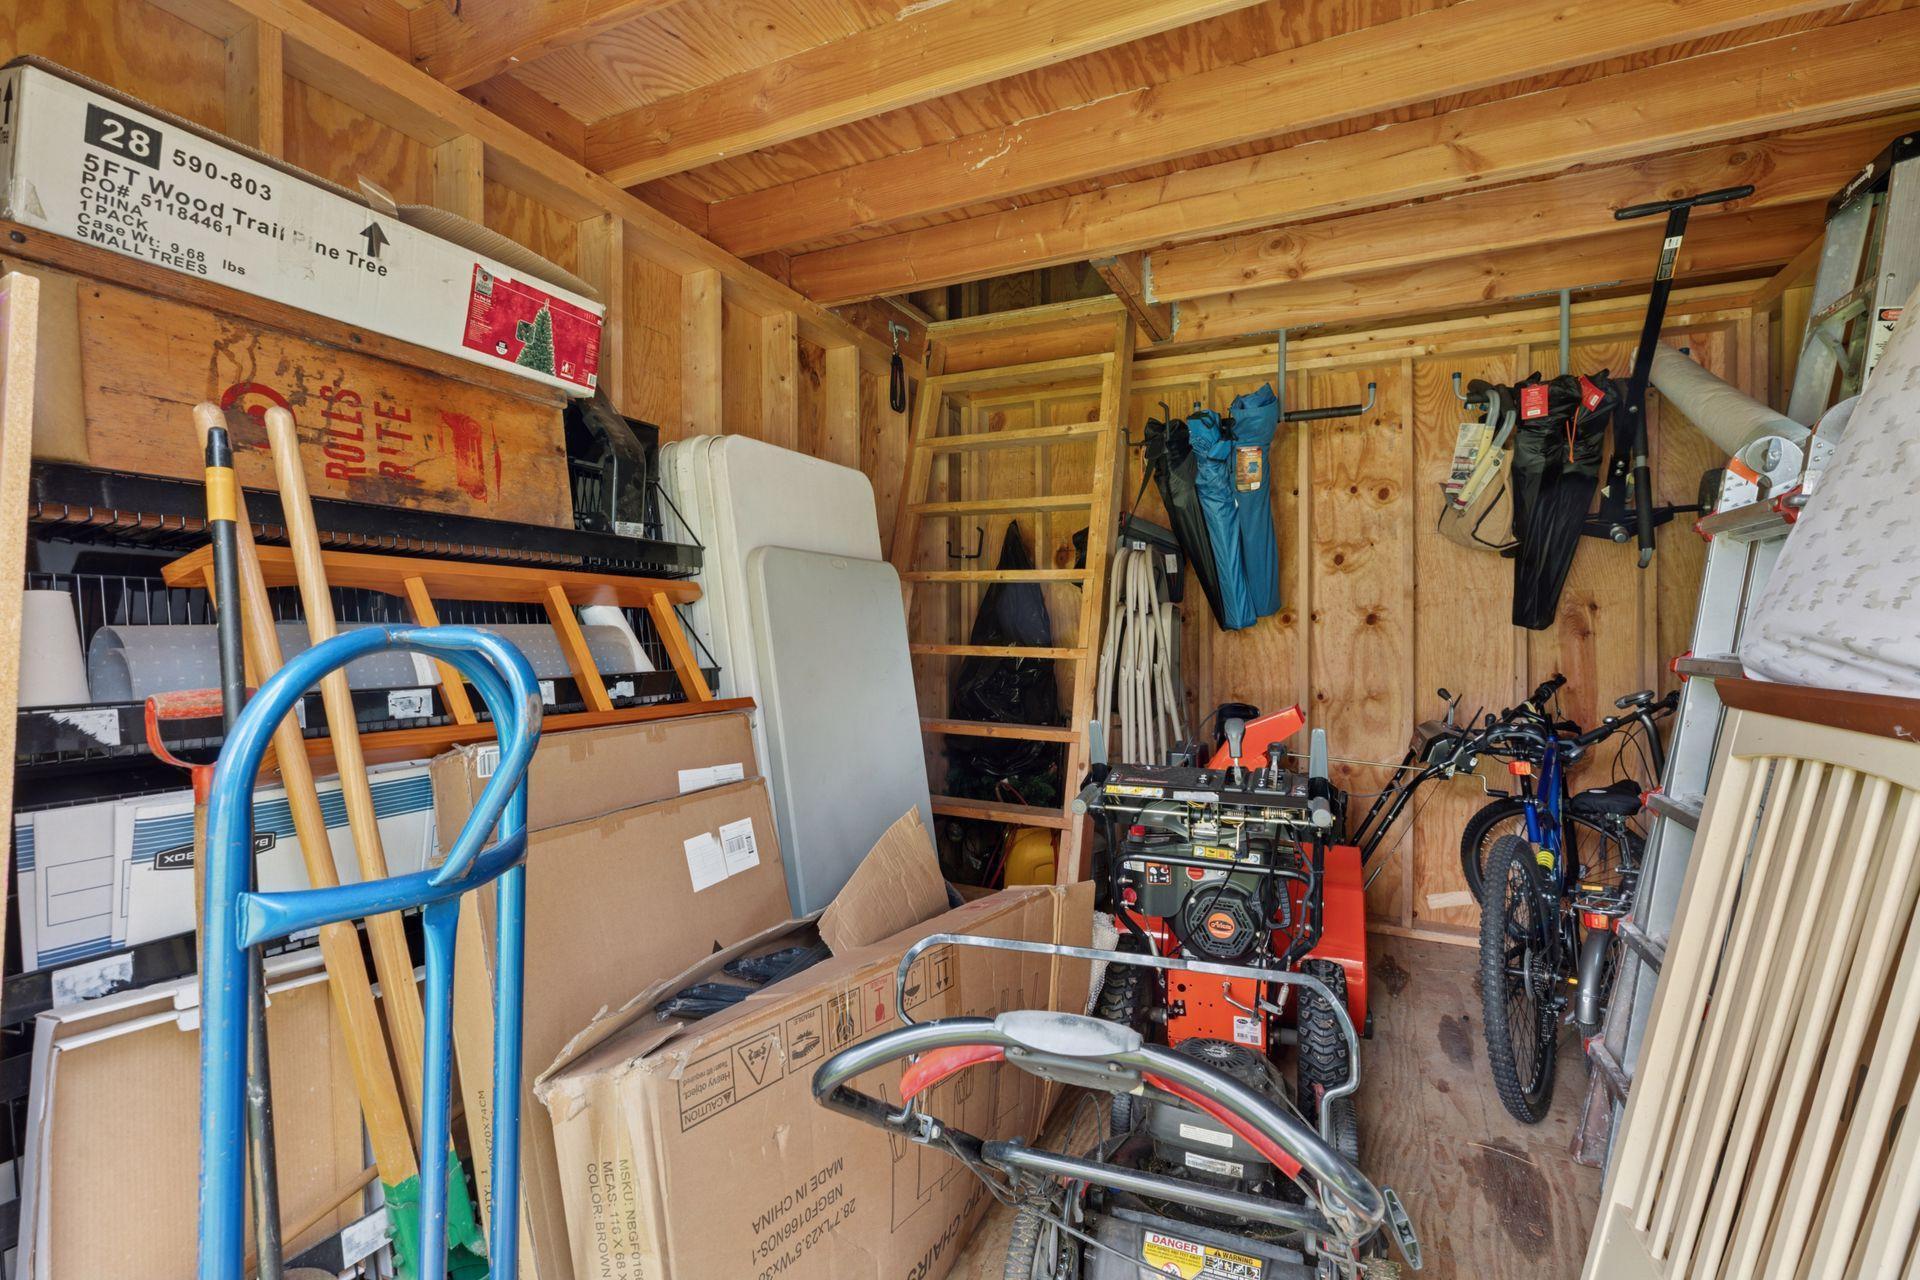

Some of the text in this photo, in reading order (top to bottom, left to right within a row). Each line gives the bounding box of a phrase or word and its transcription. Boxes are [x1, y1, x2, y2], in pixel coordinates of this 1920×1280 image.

[100, 118, 150, 158] 28
[172, 148, 271, 201] 590-803
[80, 186, 143, 217] CHINA
[80, 200, 148, 232] 1 PACK
[82, 170, 232, 237] PO# 51184461
[84, 152, 140, 187] 5FT
[149, 175, 224, 219] Wood
[346, 249, 388, 277] Tree
[76, 224, 208, 275] SMALL TREES
[77, 212, 246, 275] Case Wt: 9.68 lbs
[373, 400, 416, 481] RITE
[708, 1071, 731, 1089] Heavy
[684, 1096, 723, 1125] CAUTION
[602, 1161, 618, 1207] MEAS:
[619, 1159, 634, 1206] MSKU:
[752, 1157, 844, 1235] MADE IN CHINA
[586, 1163, 612, 1279] COLOR: BROWN
[613, 1238, 624, 1249] X
[752, 1183, 843, 1266] NBGF0166NOS-1
[1152, 1234, 1199, 1254] DANGER
[614, 1252, 627, 1270] 68
[1222, 1251, 1254, 1265] WARNING
